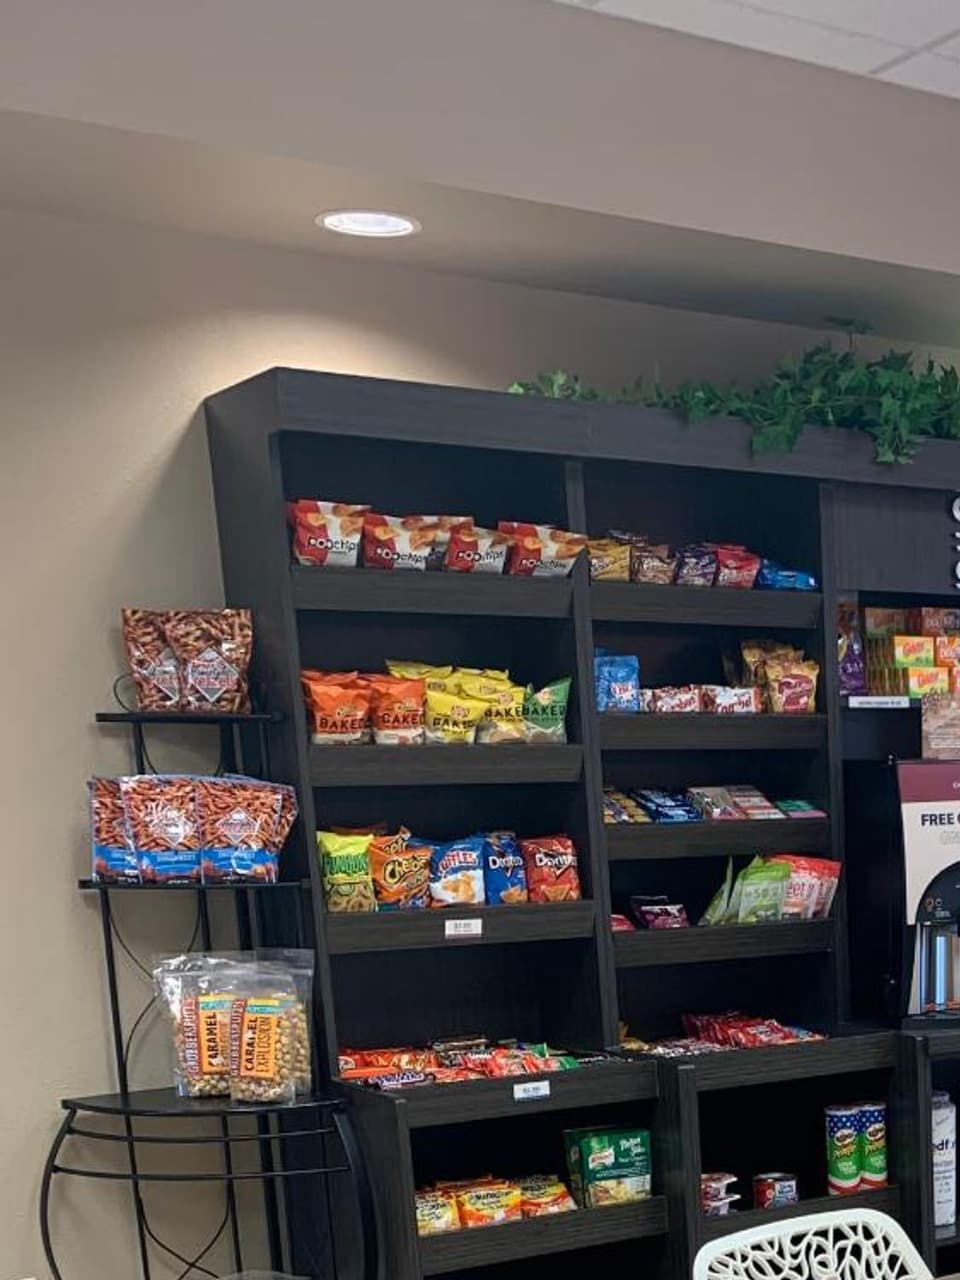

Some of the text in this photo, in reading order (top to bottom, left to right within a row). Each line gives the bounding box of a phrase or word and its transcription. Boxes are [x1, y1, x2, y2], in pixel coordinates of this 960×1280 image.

[484, 705, 523, 718] BAKE
[319, 717, 371, 730] BAKED
[920, 813, 955, 827] FREE
